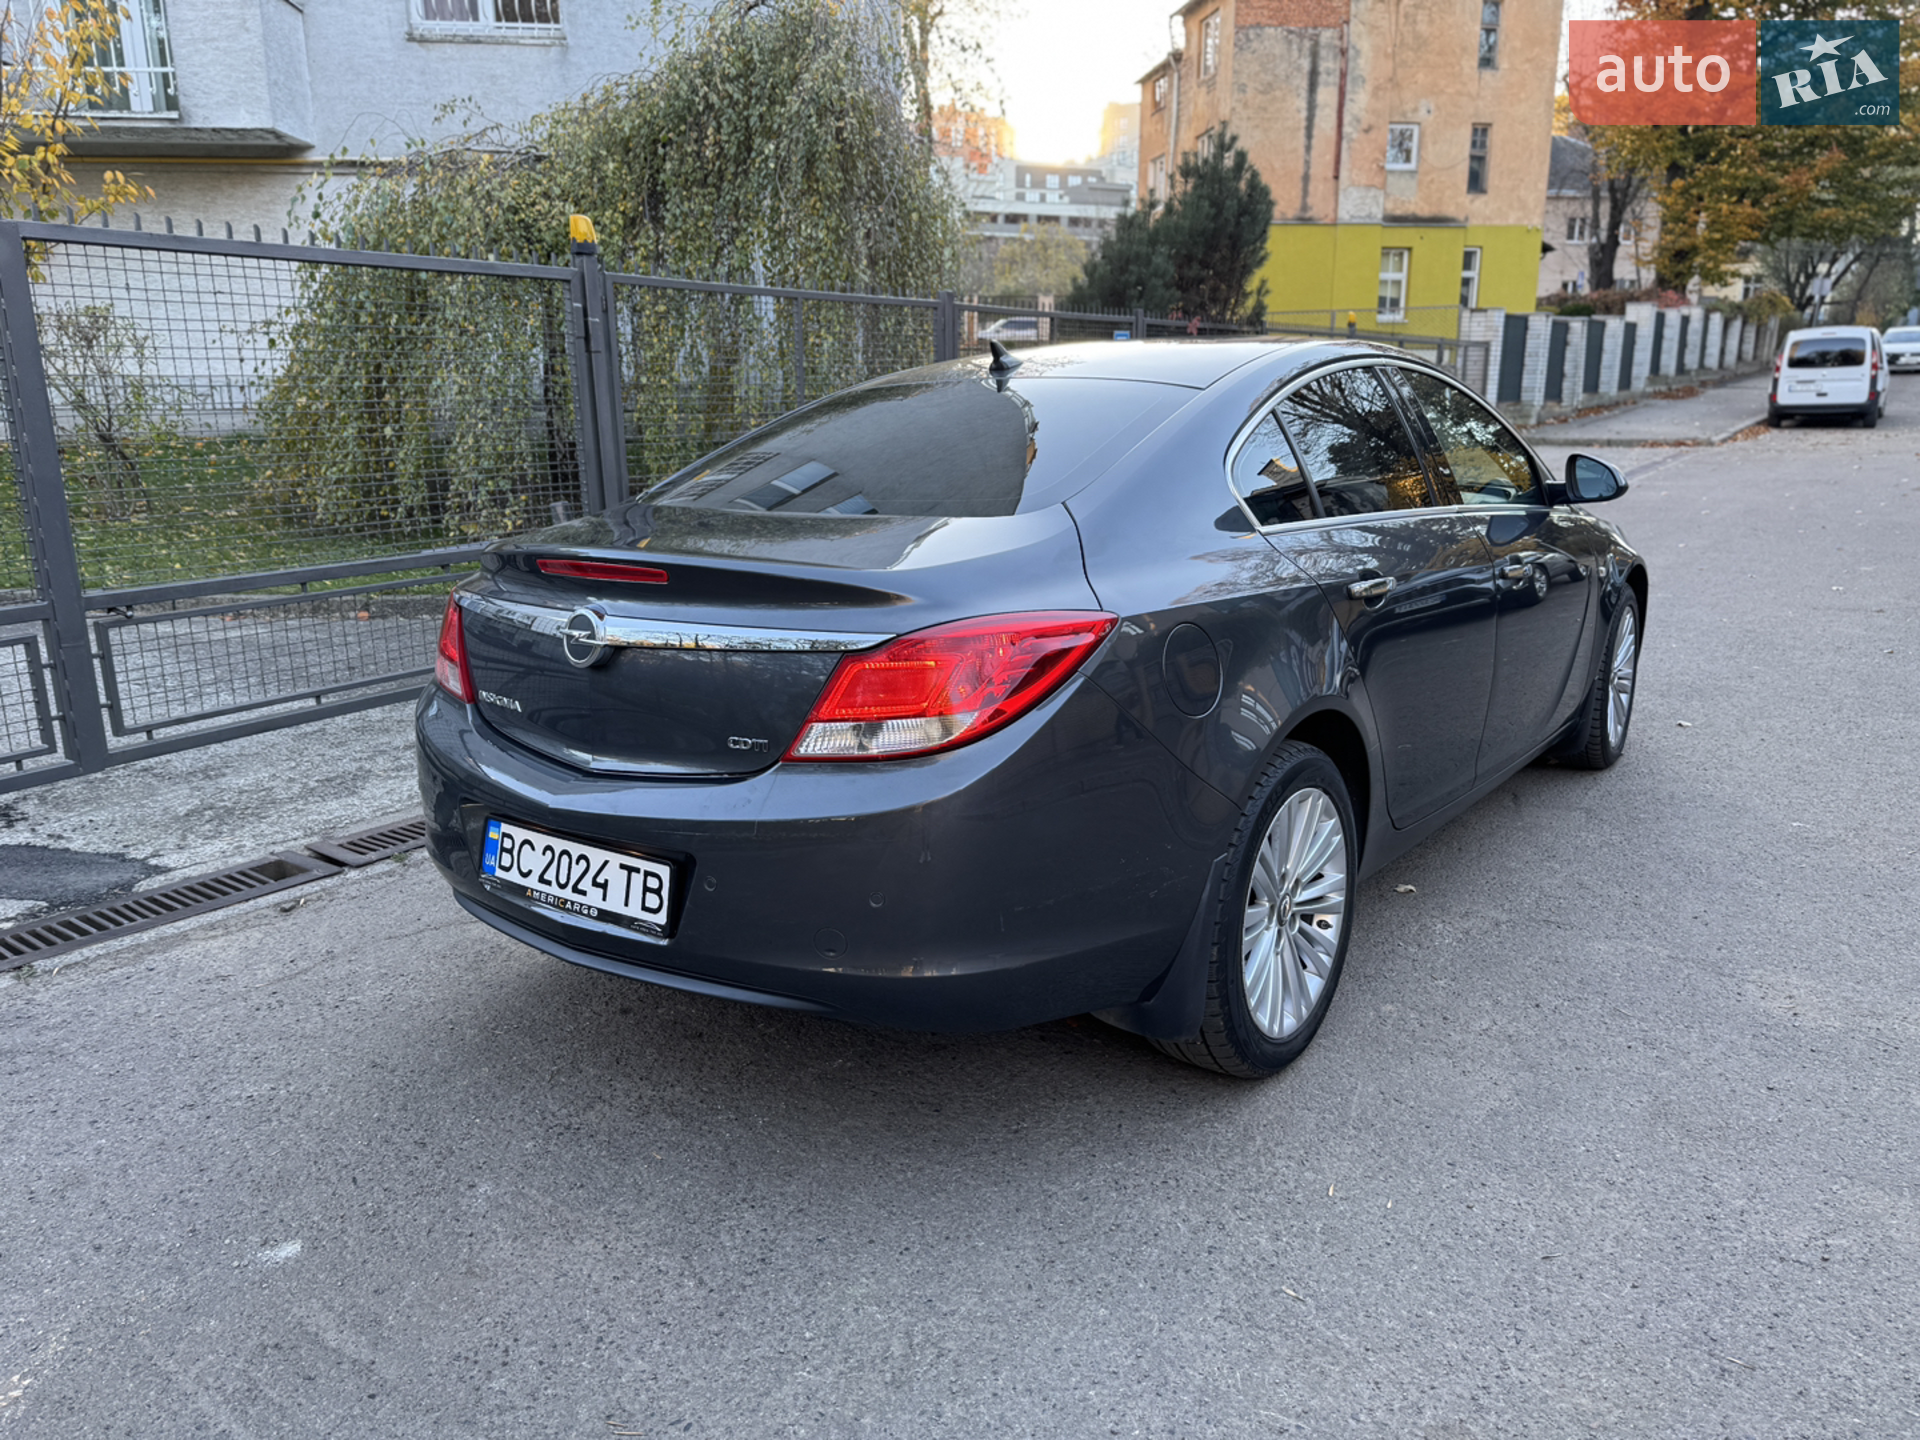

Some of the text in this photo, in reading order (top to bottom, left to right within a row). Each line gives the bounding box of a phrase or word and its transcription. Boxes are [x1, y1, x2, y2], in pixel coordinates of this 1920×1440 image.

[478, 690, 523, 713] INSIGNIA
[485, 853, 496, 867] UA
[525, 888, 598, 917] AMERICARGO
